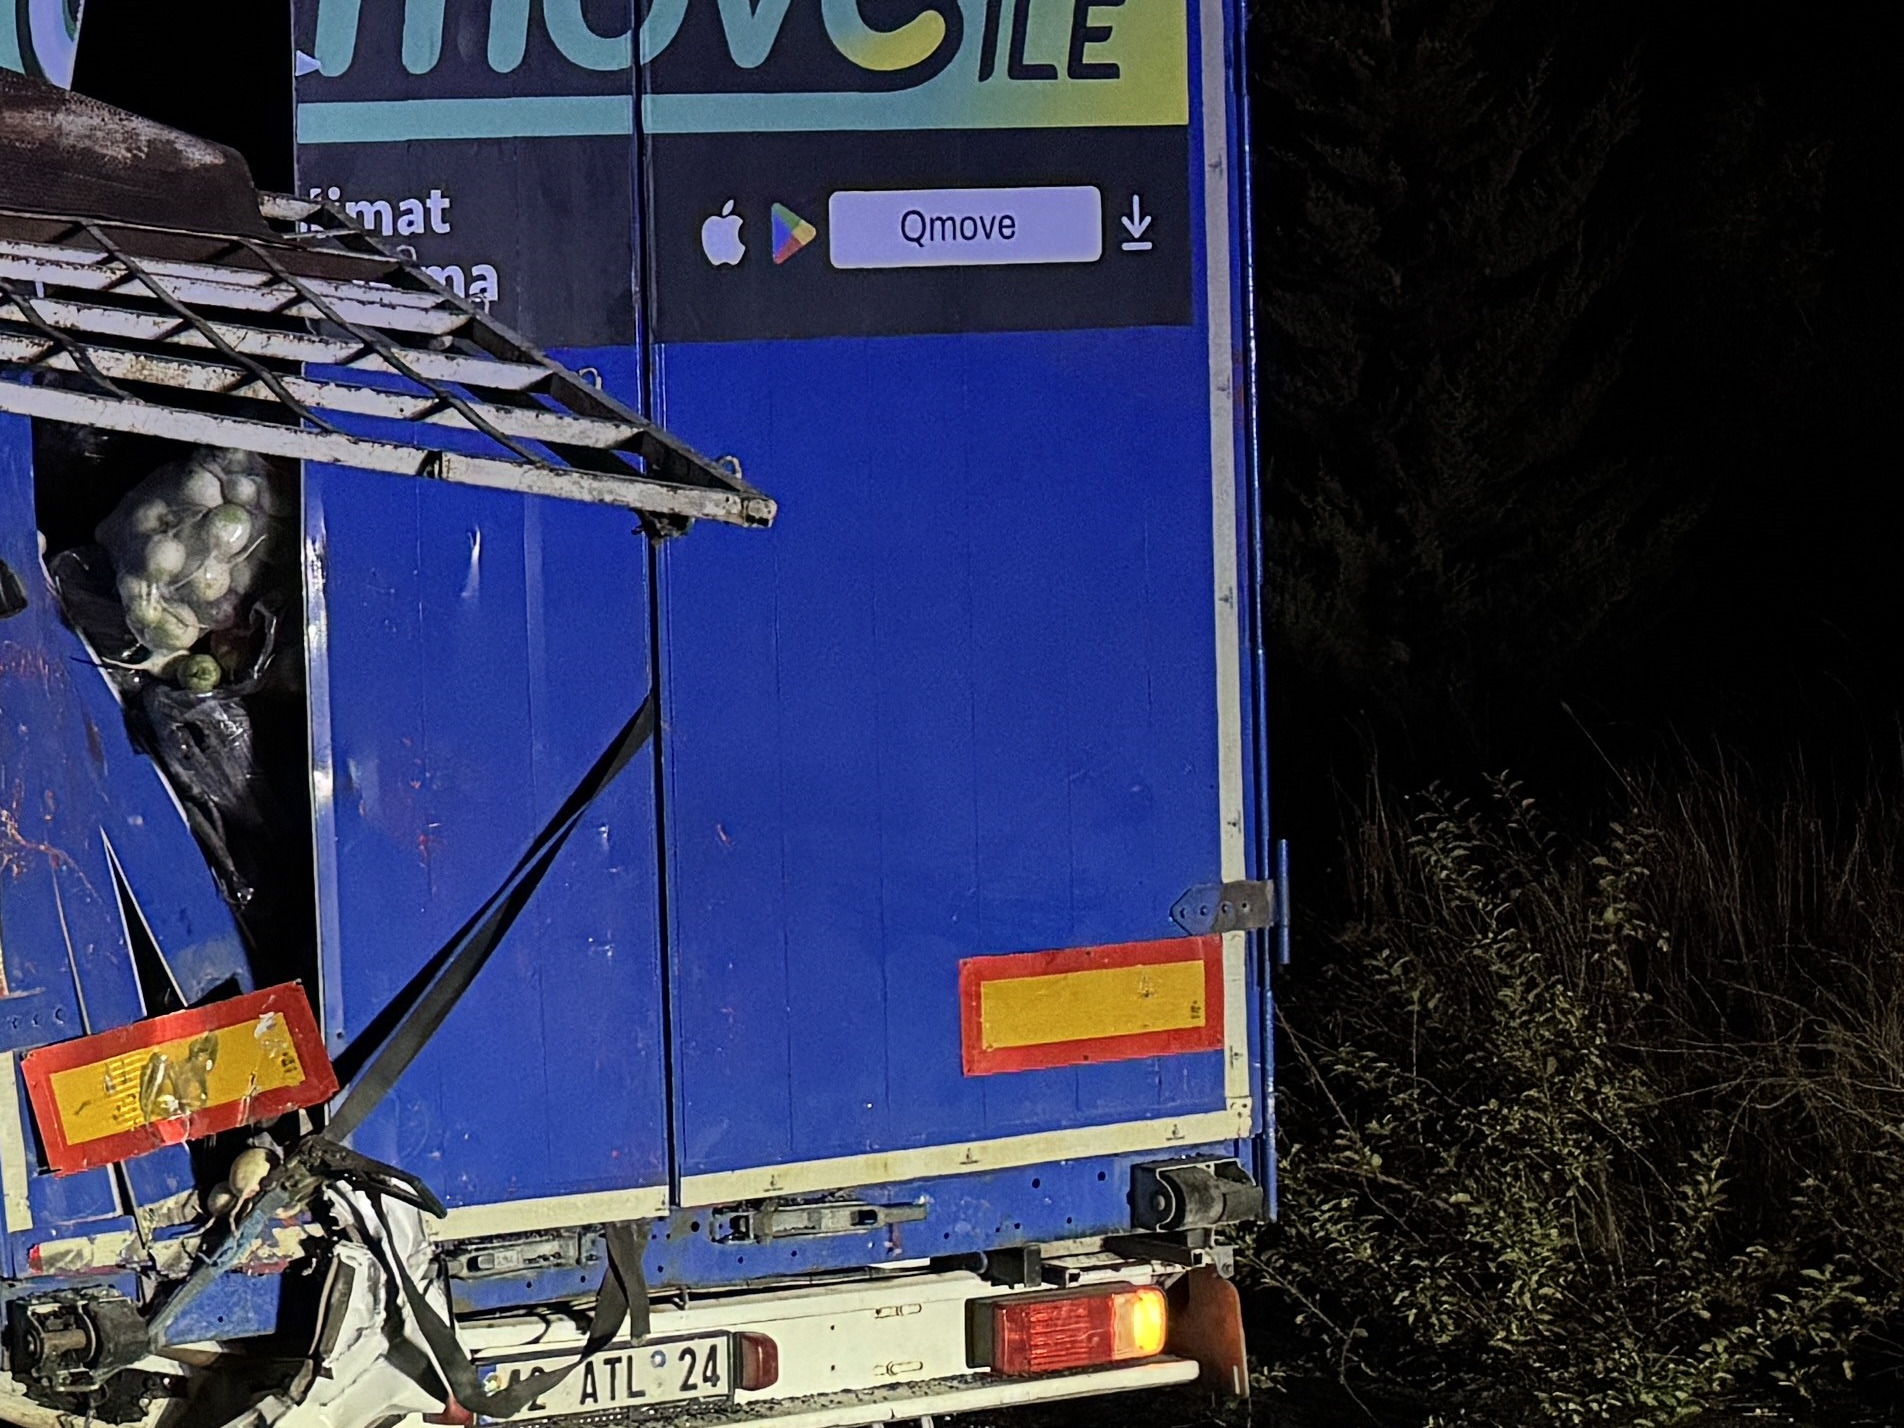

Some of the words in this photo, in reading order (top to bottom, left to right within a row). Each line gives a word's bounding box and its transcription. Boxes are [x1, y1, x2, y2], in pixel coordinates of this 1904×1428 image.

[900, 209, 1017, 248] Qmove
[579, 1354, 647, 1406] ATL
[678, 1343, 721, 1392] 24
